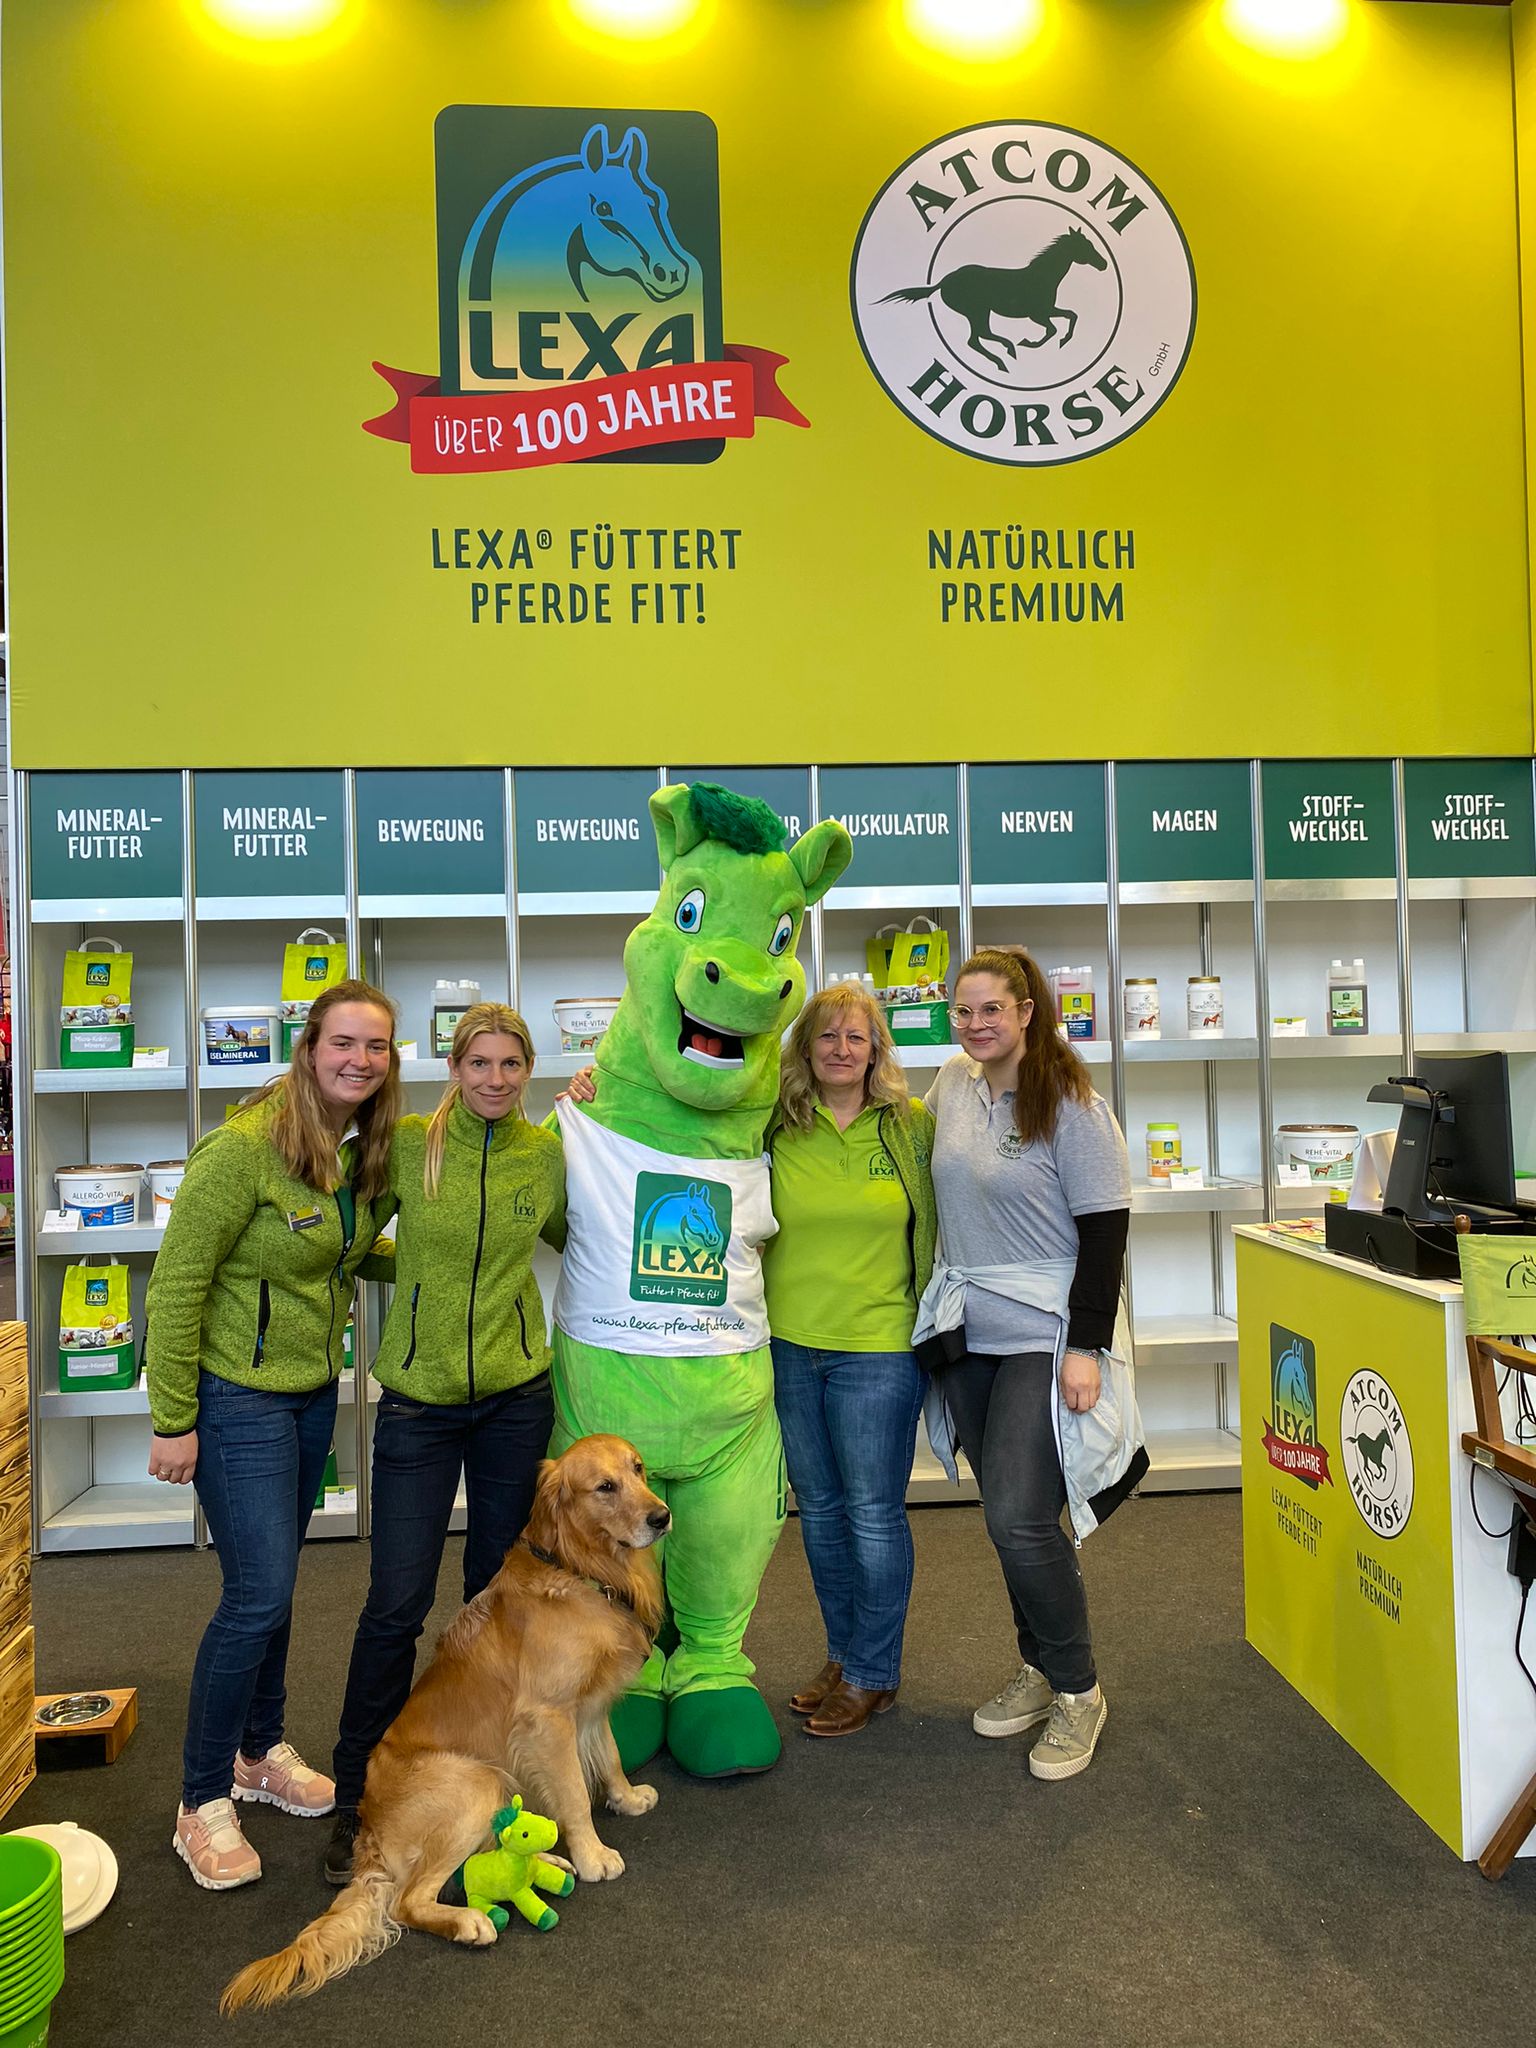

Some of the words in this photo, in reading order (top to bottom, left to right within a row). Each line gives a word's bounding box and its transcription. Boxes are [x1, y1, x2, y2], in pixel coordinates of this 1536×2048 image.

[906, 140, 1148, 236] ATCOM
[468, 311, 695, 380] LEXA
[1149, 342, 1170, 377] GmbH
[907, 358, 1146, 447] HORSE
[434, 415, 503, 455] ÜBER
[512, 402, 588, 454] 100
[597, 379, 736, 435] JAHRE
[571, 523, 743, 570] FÜTTERT
[928, 524, 1136, 570] NATÜRLICH
[472, 583, 611, 624] PFERDE
[632, 583, 707, 624] FIT!
[942, 583, 1125, 623] PREMIUM
[222, 807, 328, 831] MINERAL-
[1302, 795, 1364, 818] STOFF-
[1445, 795, 1506, 816] STOFF-
[57, 809, 163, 832] MINERAL-
[378, 819, 485, 843] BEWEGUNG
[537, 818, 640, 842] BEWEGUNG
[1001, 811, 1073, 833] NERVEN
[1152, 810, 1218, 833] MAGEN
[1288, 819, 1369, 843] WECHSEL
[1431, 819, 1510, 840] WECHSEL
[68, 836, 143, 859] FUTTER
[234, 834, 308, 857] FUTTER
[869, 1167, 894, 1176] LEXA
[72, 1191, 124, 1200] ALLERGO-VITAL
[642, 1244, 721, 1275] LEXA
[640, 1285, 675, 1296] Füttert
[677, 1287, 706, 1299] Pferde
[592, 1316, 745, 1336] www.lexa-pferdefutter.de
[1350, 1379, 1402, 1434] ATCOM
[1275, 1405, 1313, 1446] LEXA
[1283, 1449, 1297, 1469] 100
[1297, 1450, 1321, 1475] JAHRE
[1352, 1473, 1404, 1529] HORSE
[1293, 1502, 1323, 1538] FÜTTERT
[1278, 1512, 1301, 1544] PFERDE
[1303, 1532, 1317, 1557] FIT!
[1356, 1549, 1402, 1601] NATÜRLICH
[1359, 1576, 1400, 1625] PREMIUM
